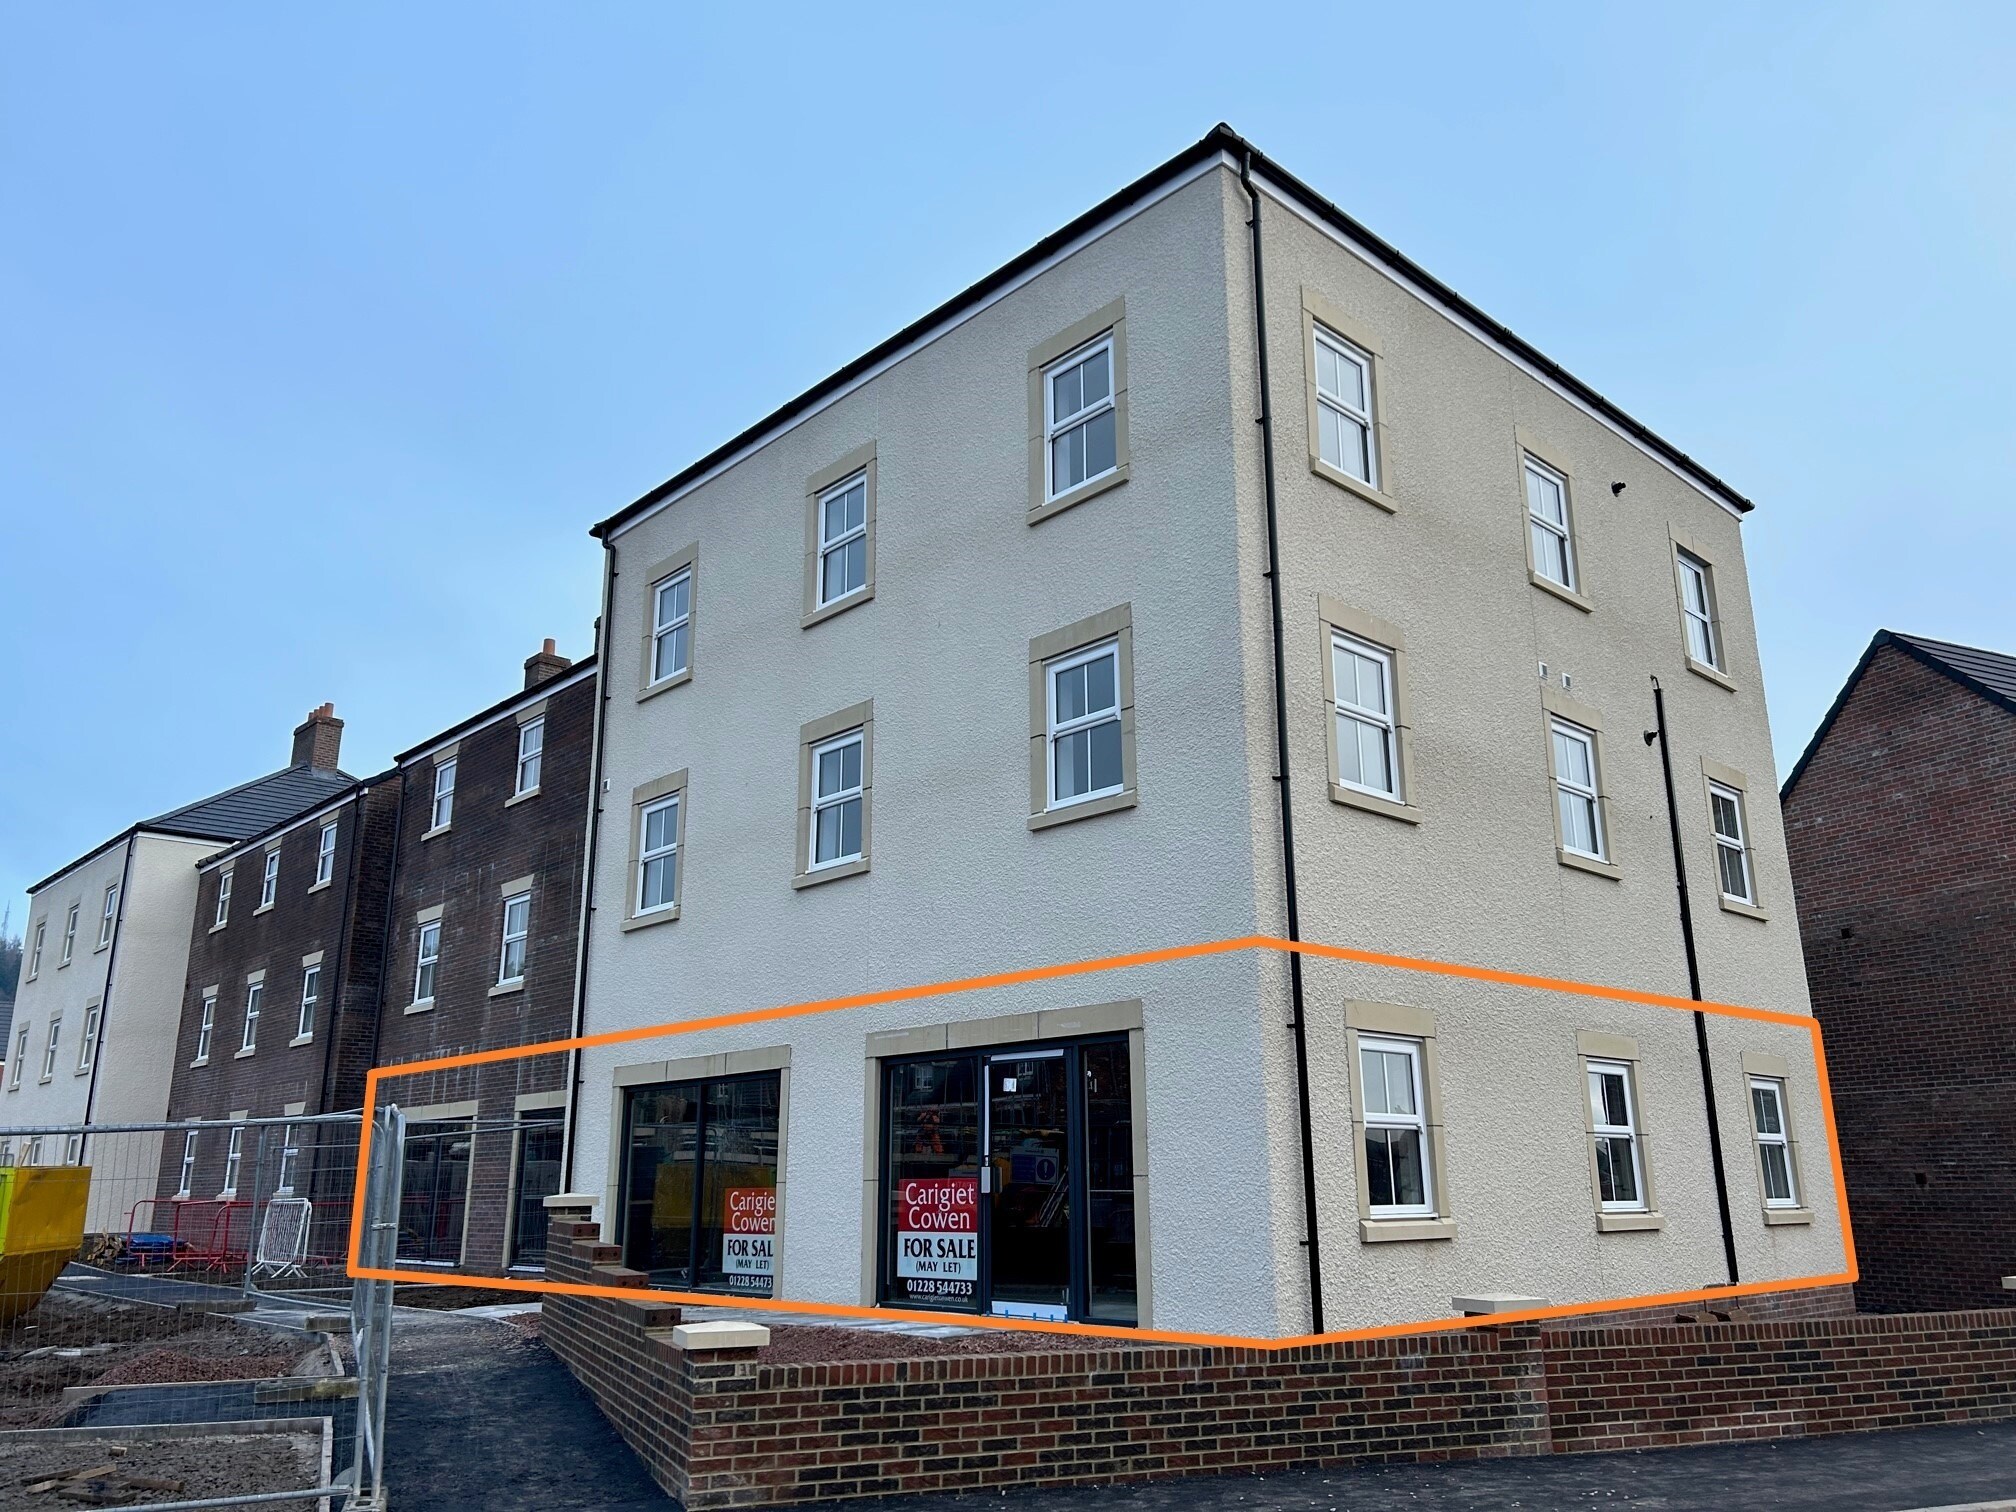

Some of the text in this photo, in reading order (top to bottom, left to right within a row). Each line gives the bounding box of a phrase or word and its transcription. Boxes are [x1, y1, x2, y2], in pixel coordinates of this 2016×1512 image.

[905, 1182, 975, 1211] Carigiet
[908, 1206, 970, 1229] Cowen
[727, 1239, 749, 1256] FOR
[903, 1238, 976, 1259] FOR SALE
[735, 1258, 770, 1271] (MAY LET)
[915, 1260, 961, 1274] (MAY LET)
[729, 1274, 750, 1287] 01228
[907, 1279, 972, 1295] 01228 544733
